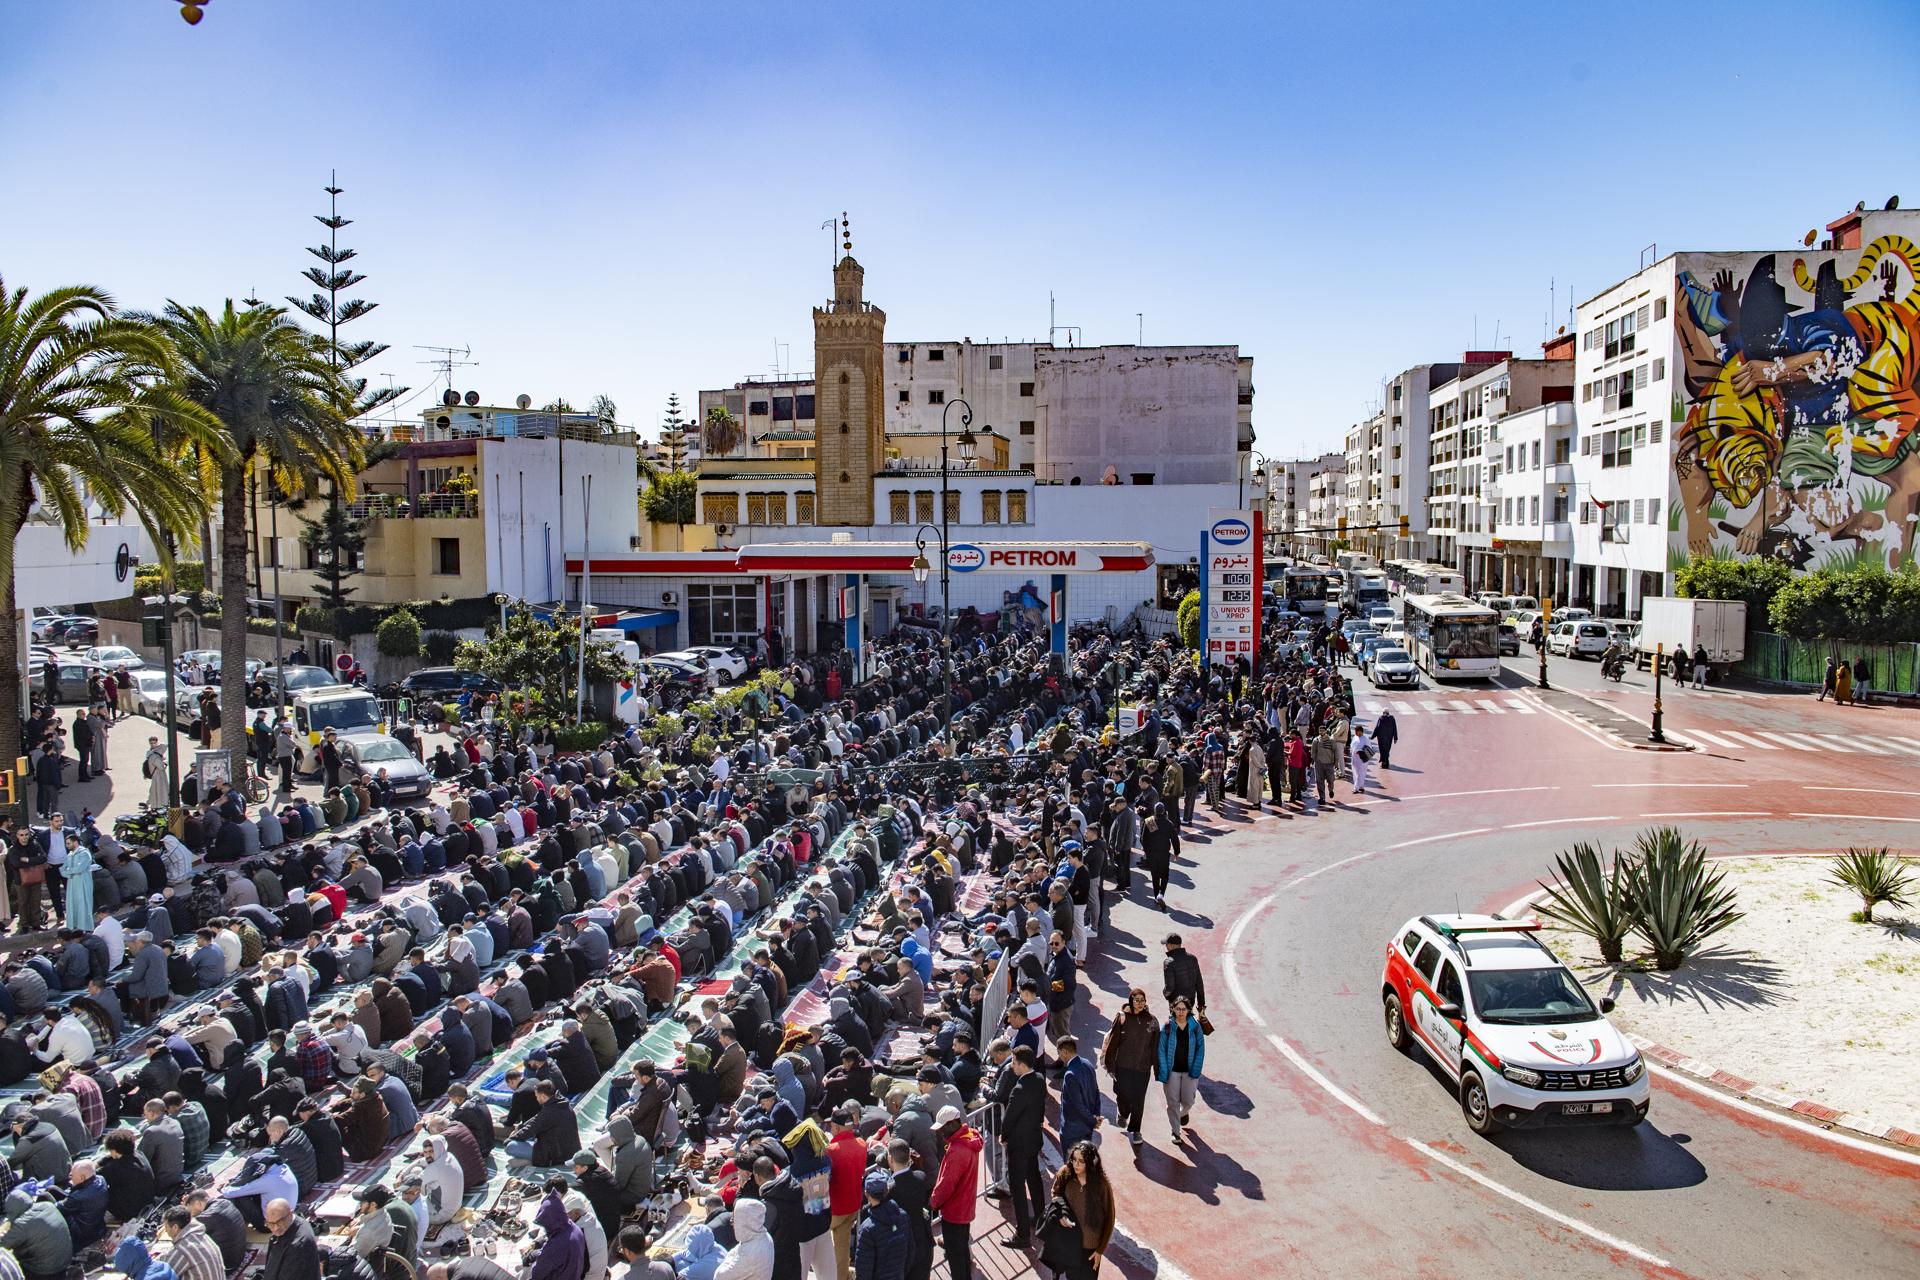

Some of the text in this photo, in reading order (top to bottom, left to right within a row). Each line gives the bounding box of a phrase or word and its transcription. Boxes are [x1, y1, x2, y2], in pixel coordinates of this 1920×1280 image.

[950, 551, 979, 564] بتروم
[990, 550, 1076, 566] PETROM
[1213, 555, 1249, 570] بتروم
